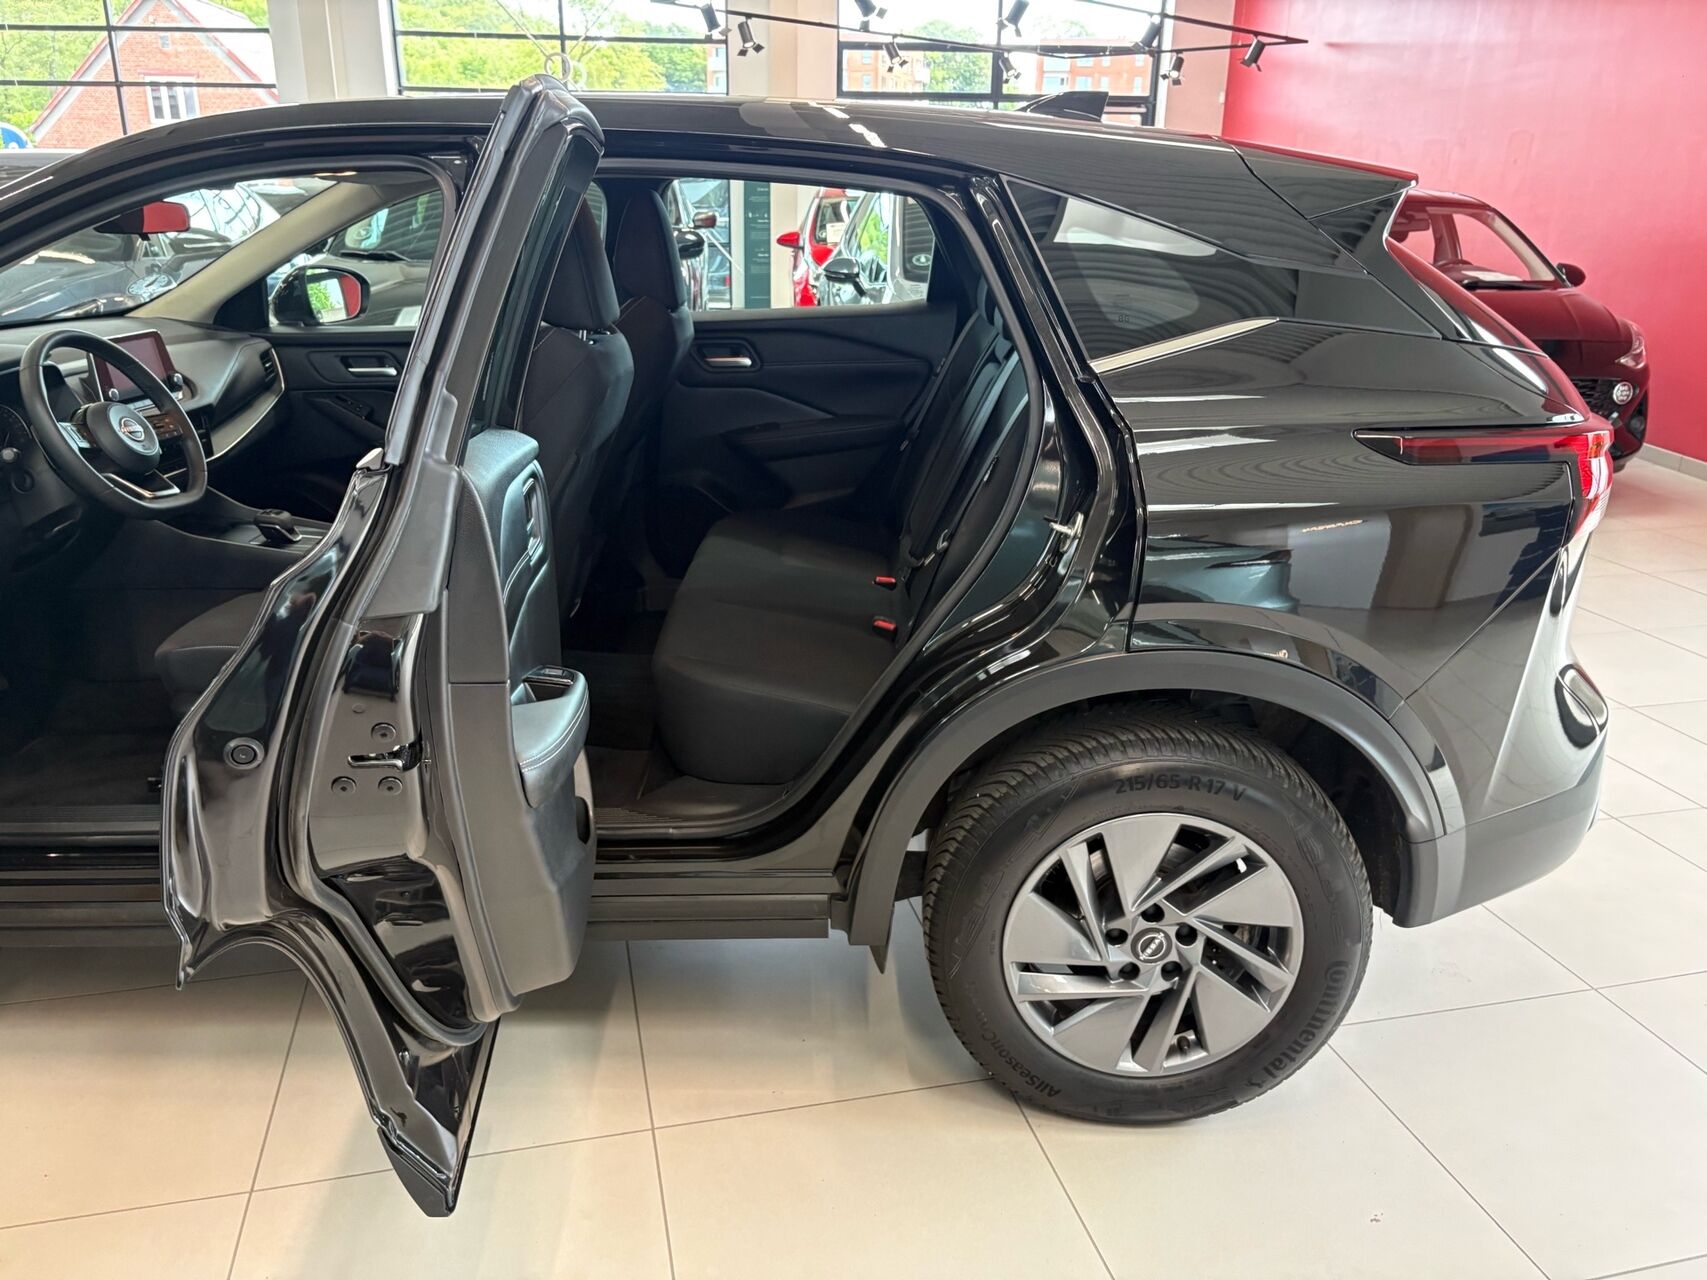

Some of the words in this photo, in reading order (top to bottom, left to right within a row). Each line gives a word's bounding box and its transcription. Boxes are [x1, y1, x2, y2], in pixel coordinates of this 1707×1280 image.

[1115, 775, 1181, 794] 215/65
[1187, 775, 1201, 791] R
[1206, 777, 1226, 795] 17
[1232, 784, 1248, 802] V
[1139, 932, 1165, 960] NISSAN
[1263, 960, 1350, 1079] Continental
